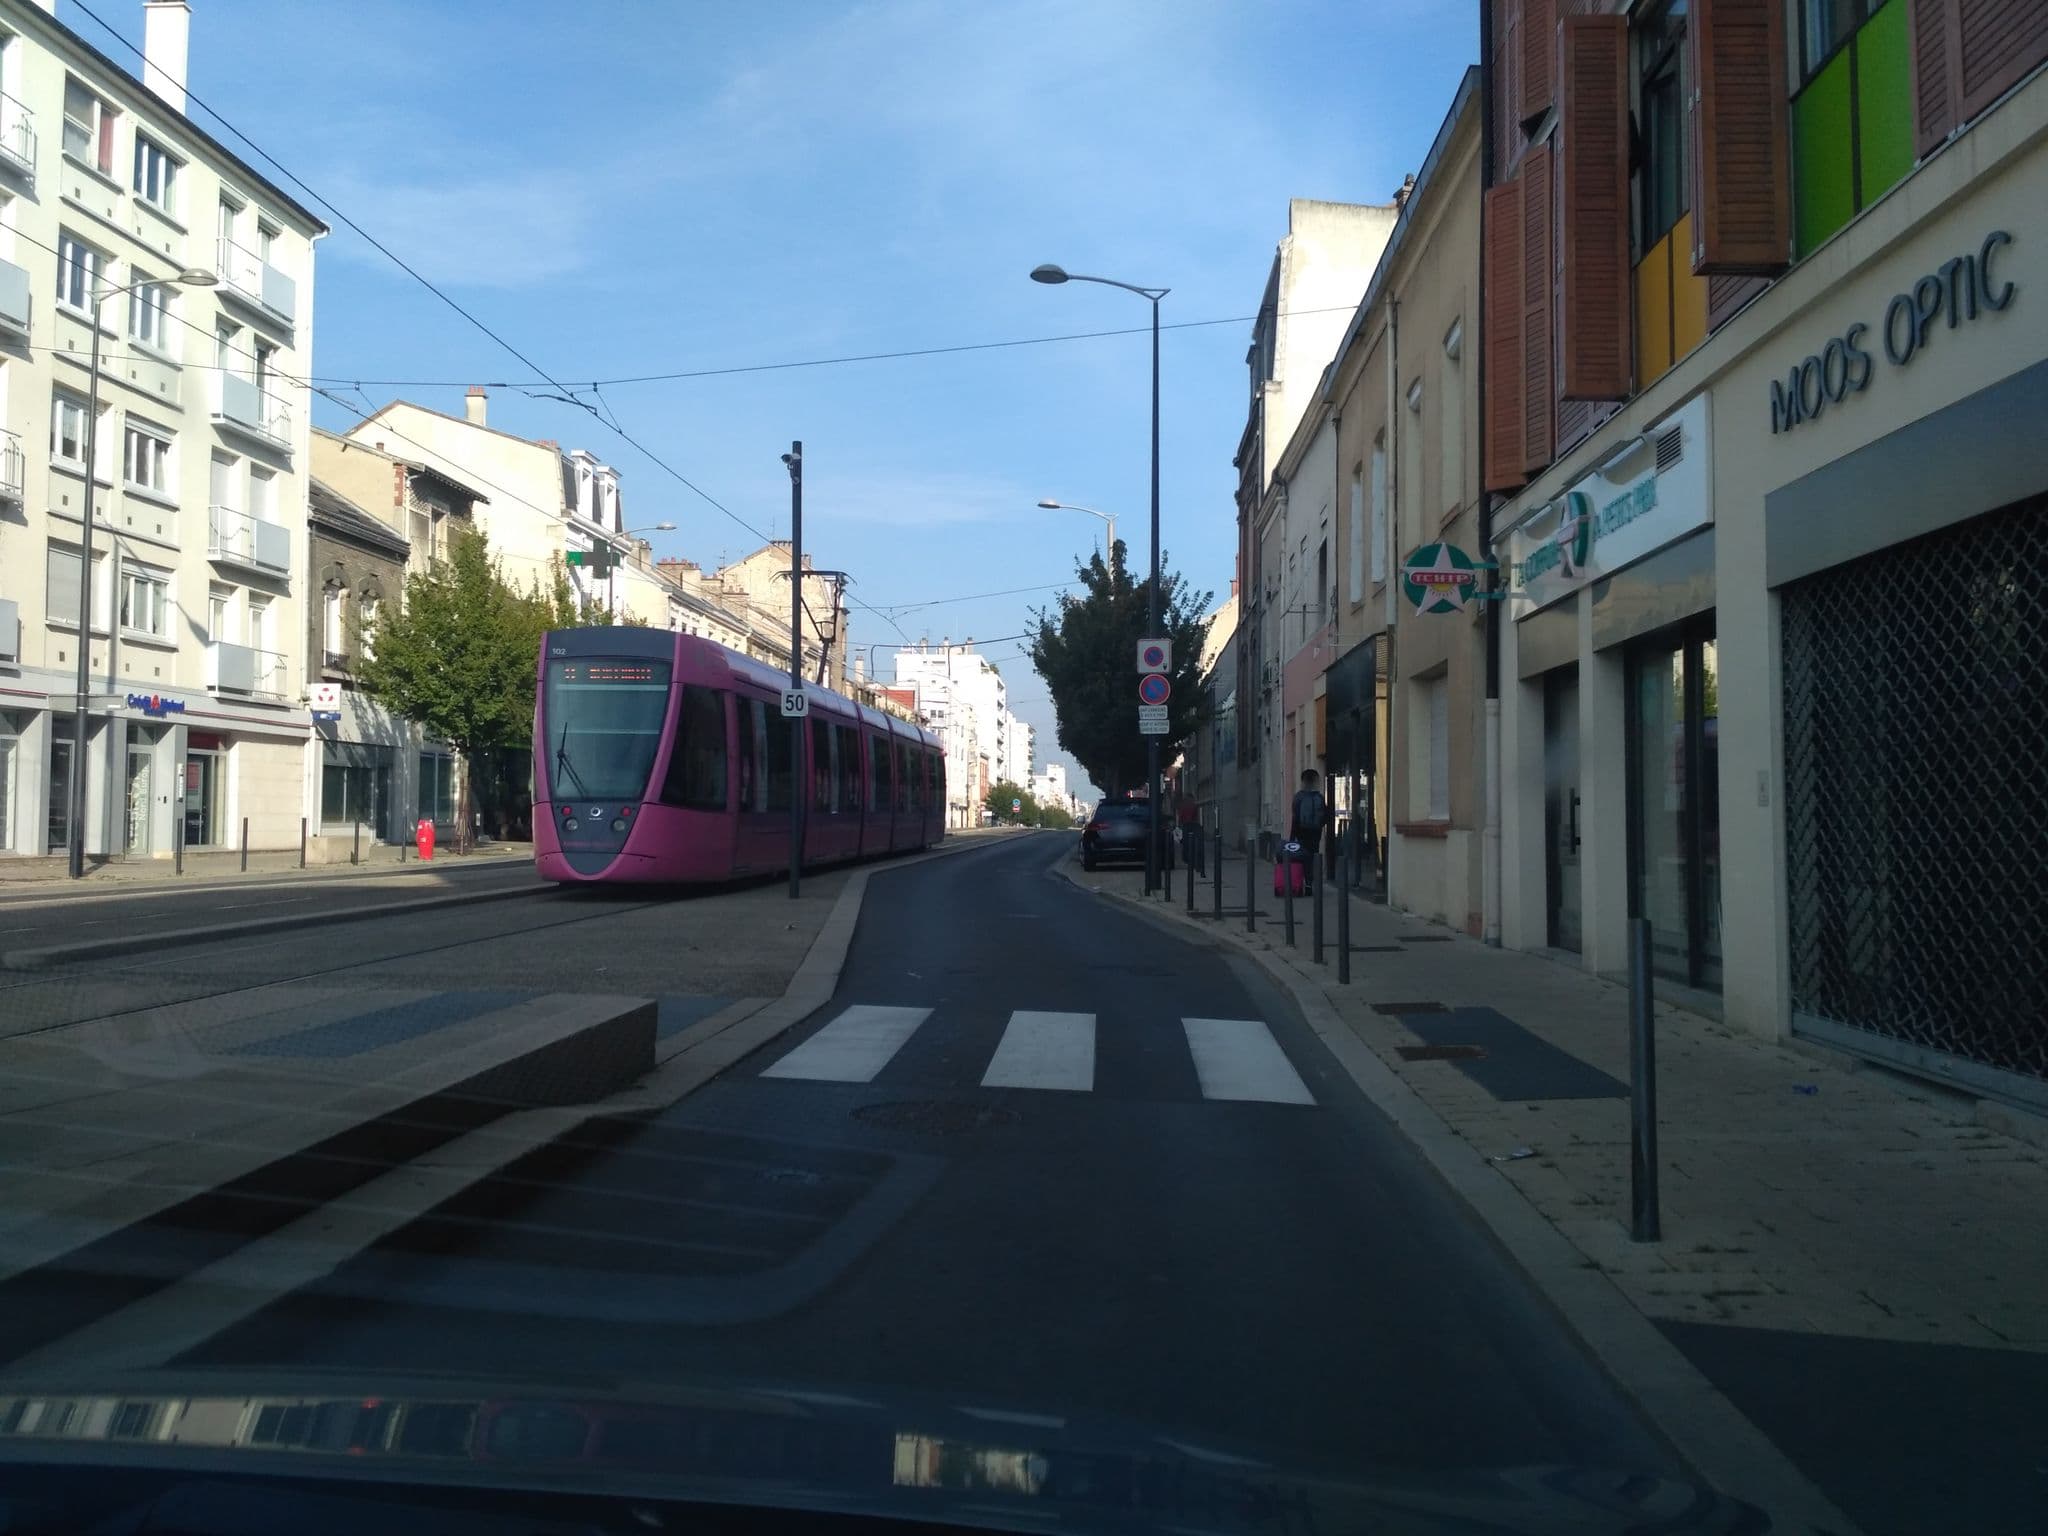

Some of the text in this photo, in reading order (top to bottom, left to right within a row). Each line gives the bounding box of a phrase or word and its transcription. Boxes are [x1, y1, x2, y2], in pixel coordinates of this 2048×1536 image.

[1771, 230, 2014, 433] MOOS OPTIC
[1412, 574, 1470, 582] TCHIP
[786, 695, 804, 711] 50
